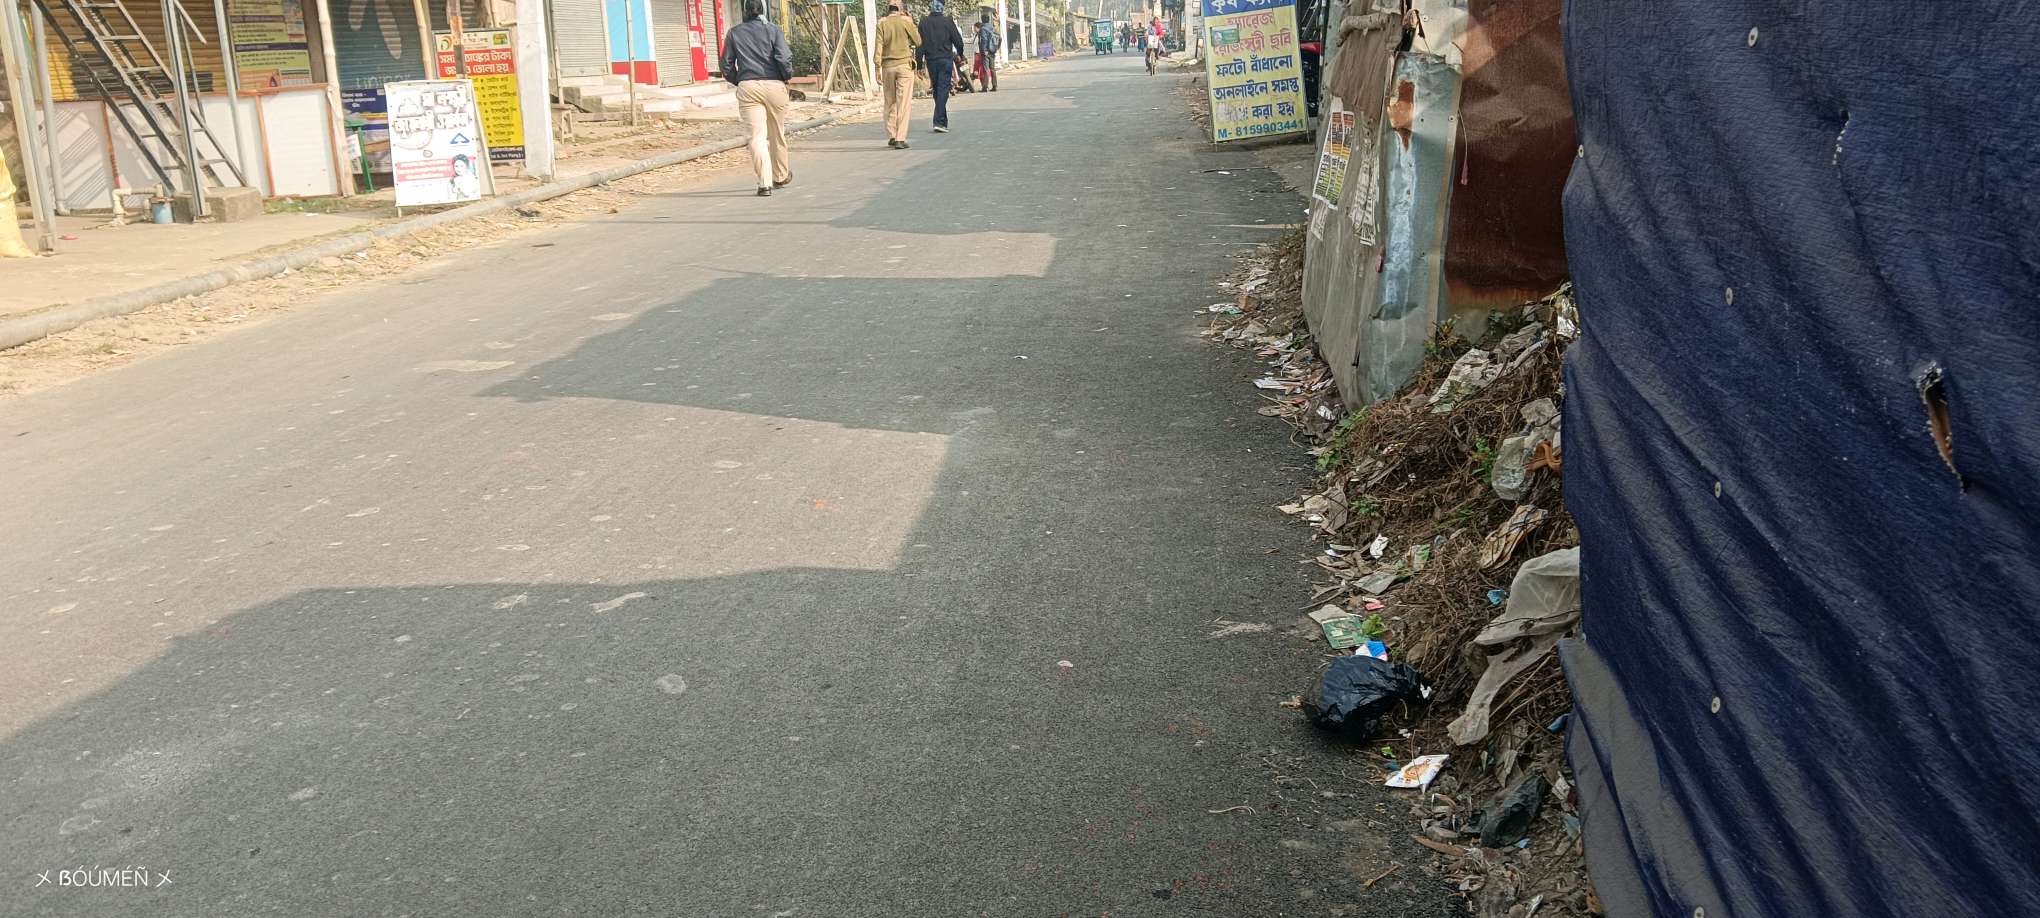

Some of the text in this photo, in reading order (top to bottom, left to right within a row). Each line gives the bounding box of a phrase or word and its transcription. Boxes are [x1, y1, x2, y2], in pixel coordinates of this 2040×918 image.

[1215, 54, 1294, 77] ফটো বাঁধানো
[1213, 77, 1300, 100] অনলাইনে সমস্ত
[1251, 104, 1273, 120] করা
